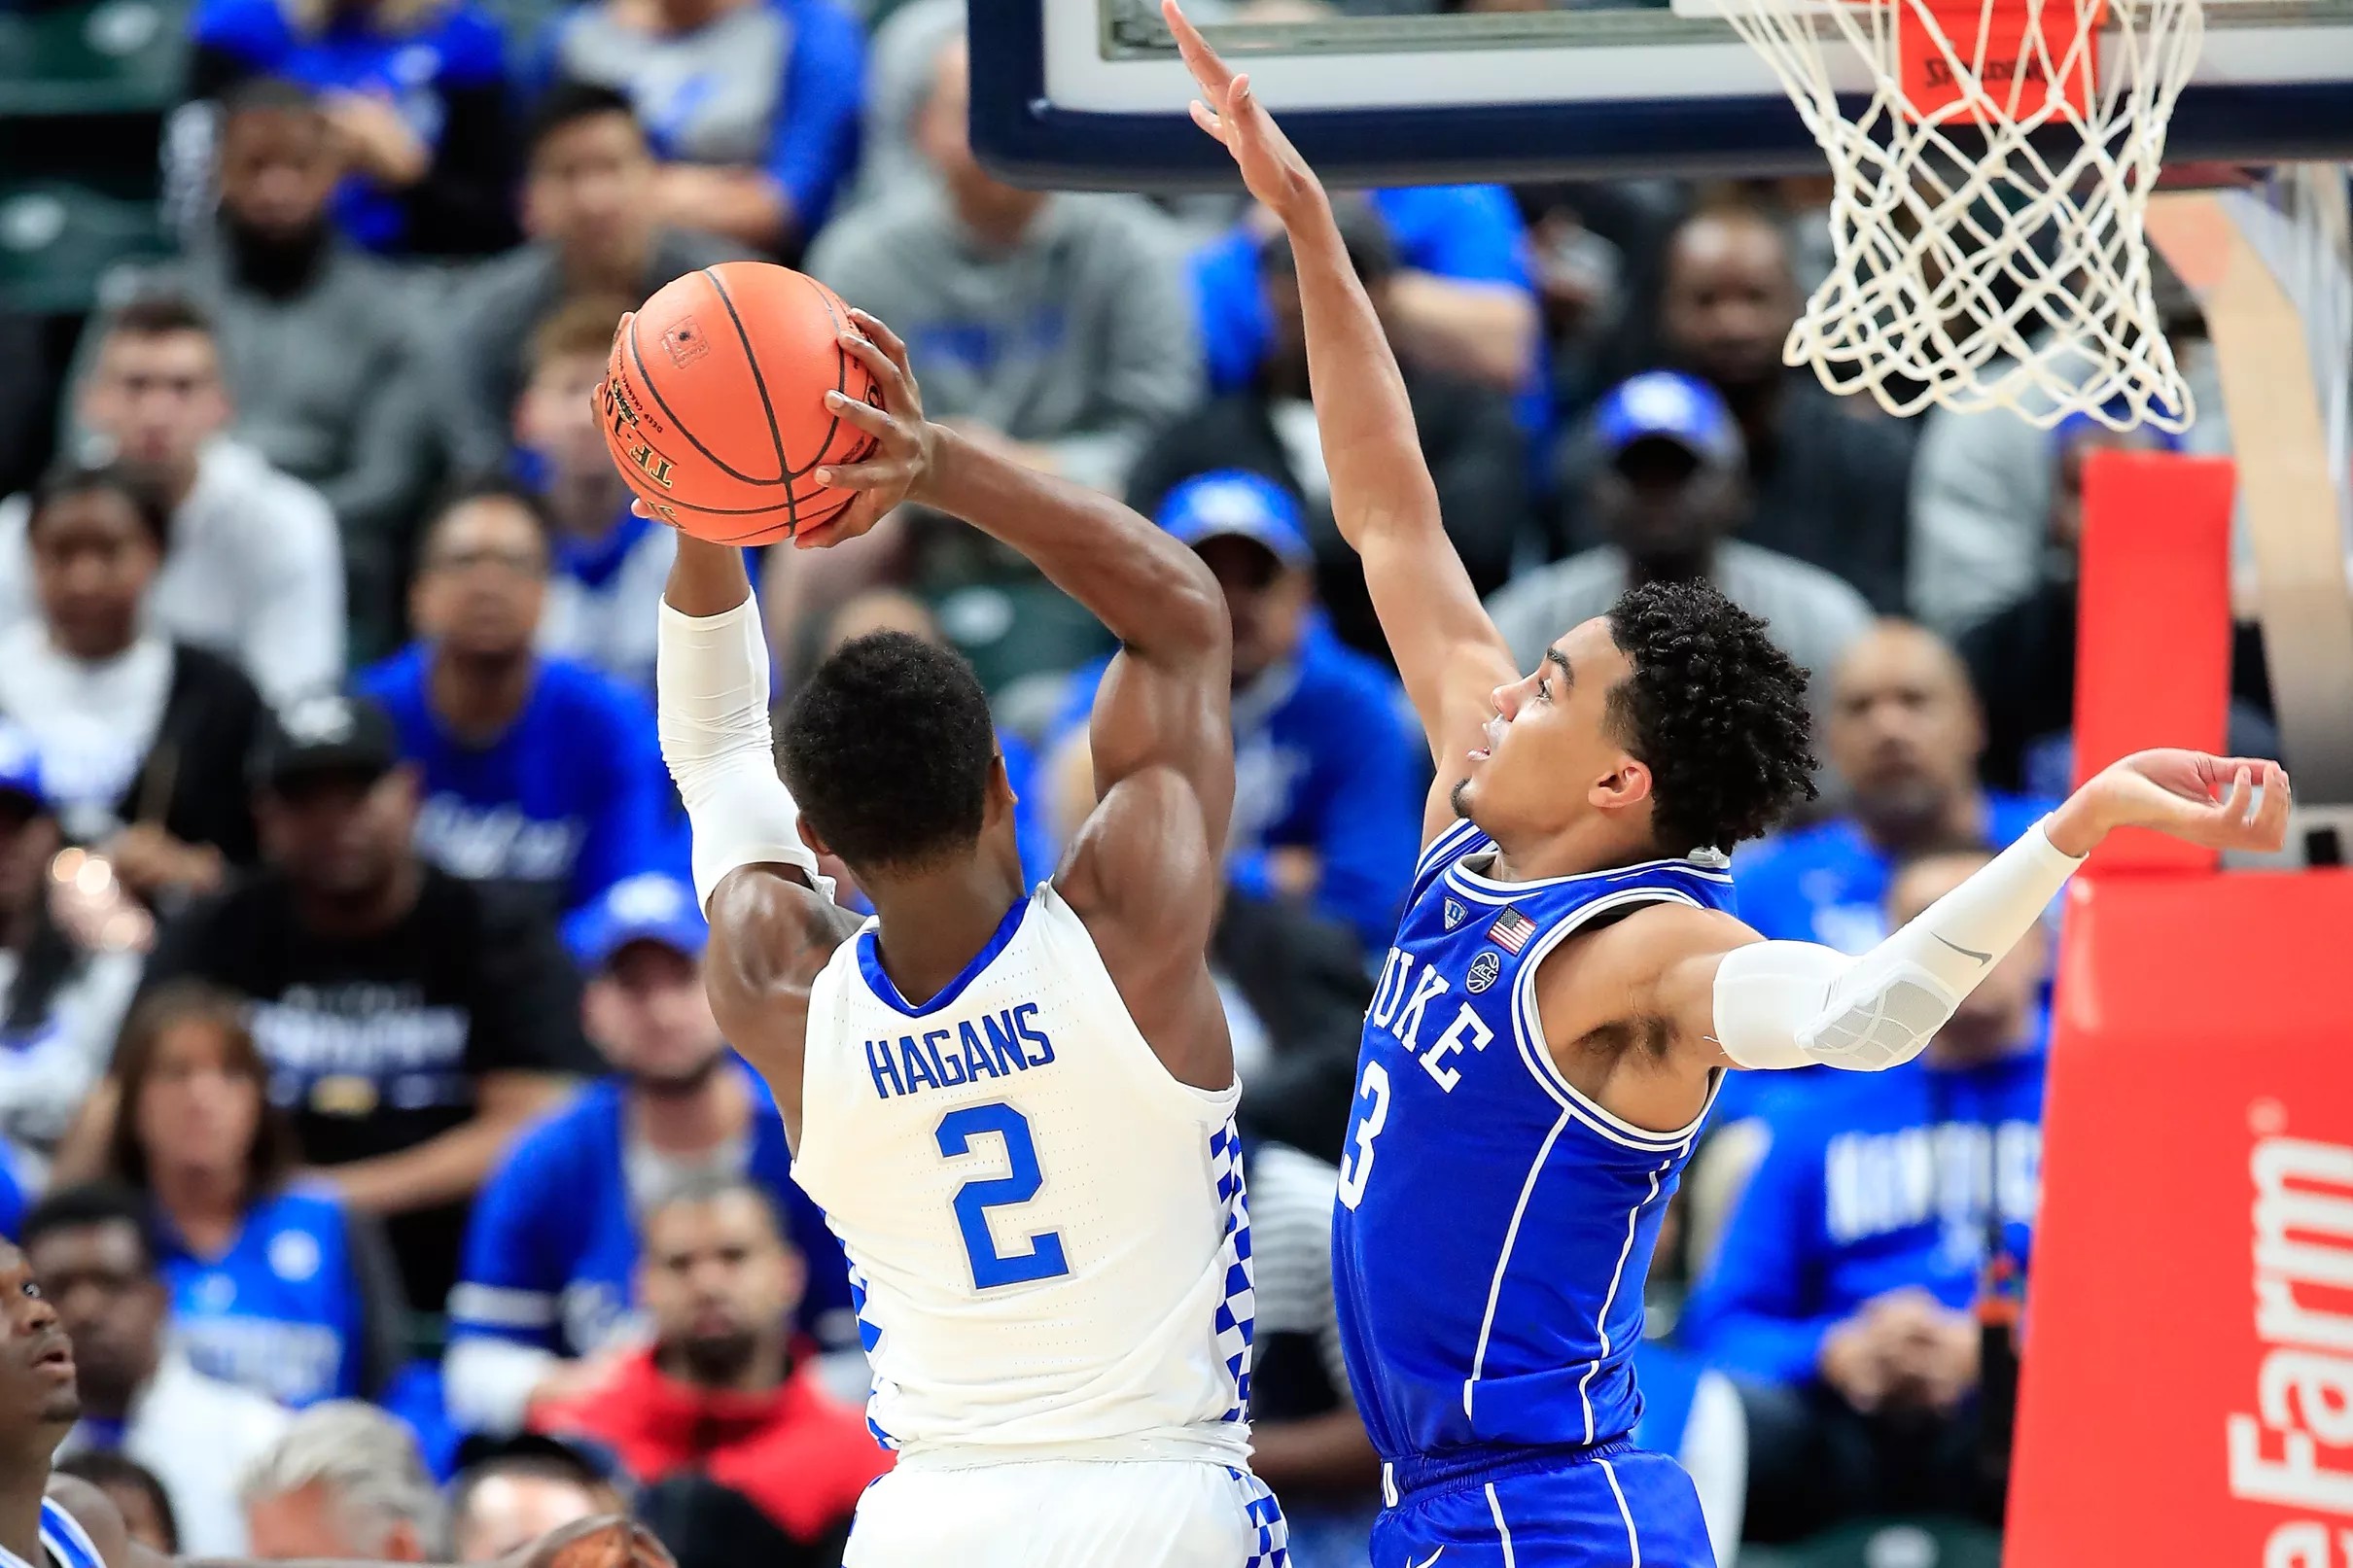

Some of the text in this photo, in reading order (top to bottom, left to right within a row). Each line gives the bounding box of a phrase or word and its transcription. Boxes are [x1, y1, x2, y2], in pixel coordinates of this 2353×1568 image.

[864, 1002, 1055, 1099] HAGANS
[1363, 946, 1494, 1094] UKE
[931, 1098, 1073, 1293] 2
[1337, 1060, 1390, 1212] 3
